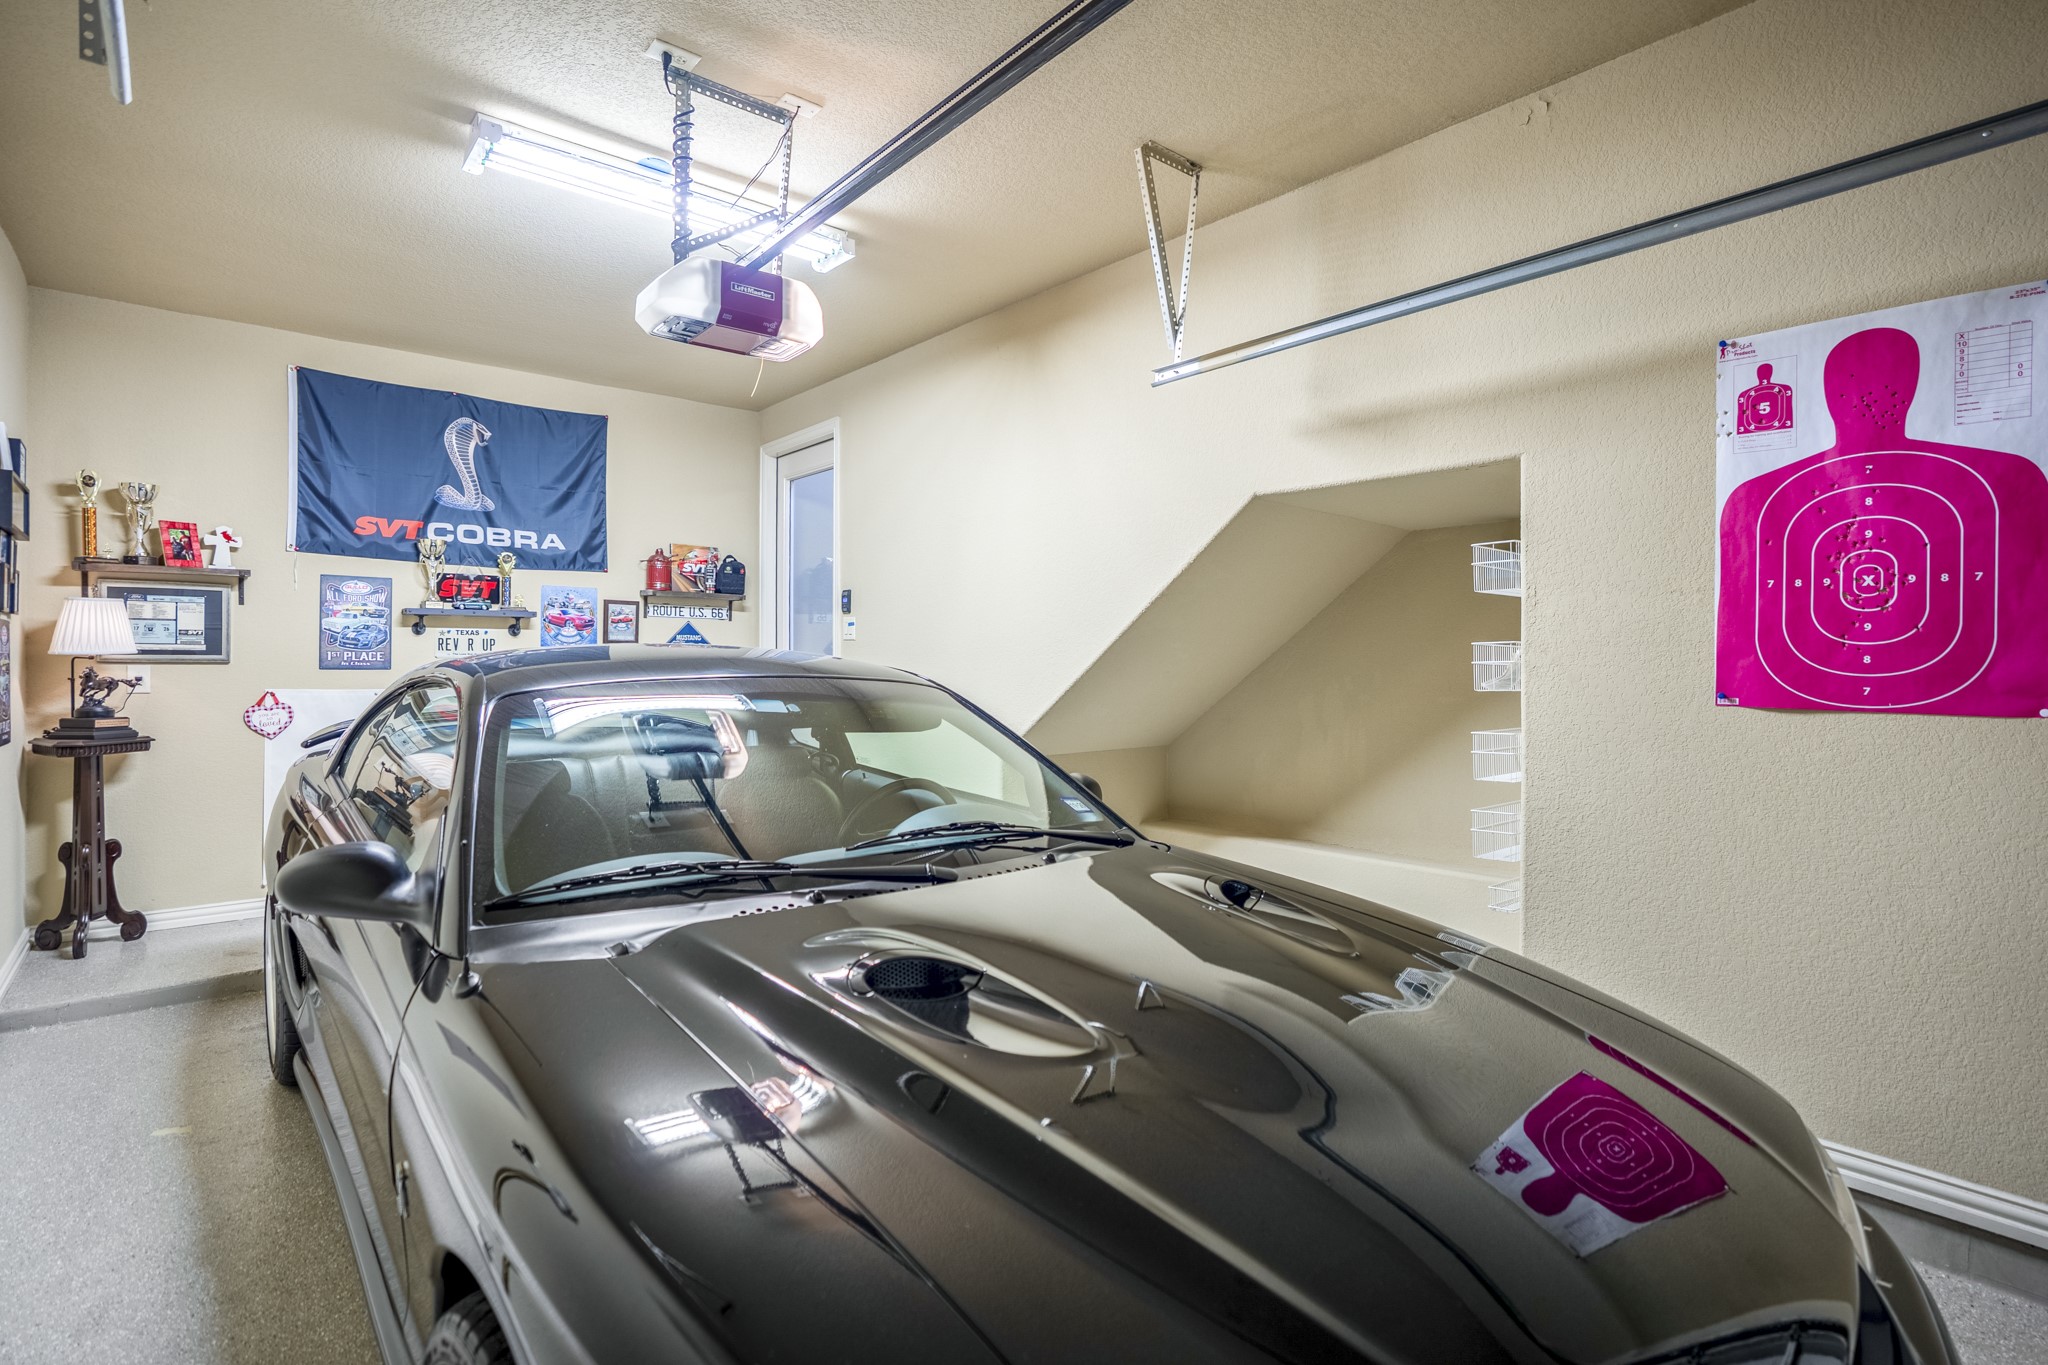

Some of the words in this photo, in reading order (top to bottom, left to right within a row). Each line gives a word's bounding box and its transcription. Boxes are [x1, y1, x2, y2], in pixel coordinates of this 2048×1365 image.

[734, 283, 772, 298] LiftMaster
[1957, 340, 1967, 348] 10
[1759, 402, 1771, 415] 5
[1865, 465, 1873, 474] 7
[1865, 497, 1873, 506] 8
[353, 516, 424, 540] SVT
[426, 522, 566, 551] COBRA
[1864, 529, 1873, 538] 9
[682, 562, 707, 573] SVT
[1767, 580, 1775, 589] 7
[1794, 579, 1802, 587] 8
[1823, 578, 1831, 586] 9
[1861, 574, 1875, 587] X
[1908, 574, 1917, 583] 9
[1940, 573, 1949, 582] 8
[1975, 571, 1984, 581] 7
[438, 578, 497, 599] SVT
[326, 589, 340, 602] ALL
[343, 594, 363, 602] FORD
[364, 591, 388, 603] SHOW
[652, 605, 685, 617] ROUTE
[689, 607, 707, 618] U.S.
[711, 608, 724, 619] 66
[1863, 622, 1872, 631] 9
[437, 637, 459, 652] REV
[467, 638, 474, 651] R
[482, 638, 496, 651] UP
[326, 651, 341, 661] 1ST
[343, 651, 385, 661] PLACE
[1863, 655, 1871, 664] 8
[1863, 687, 1871, 696] 7
